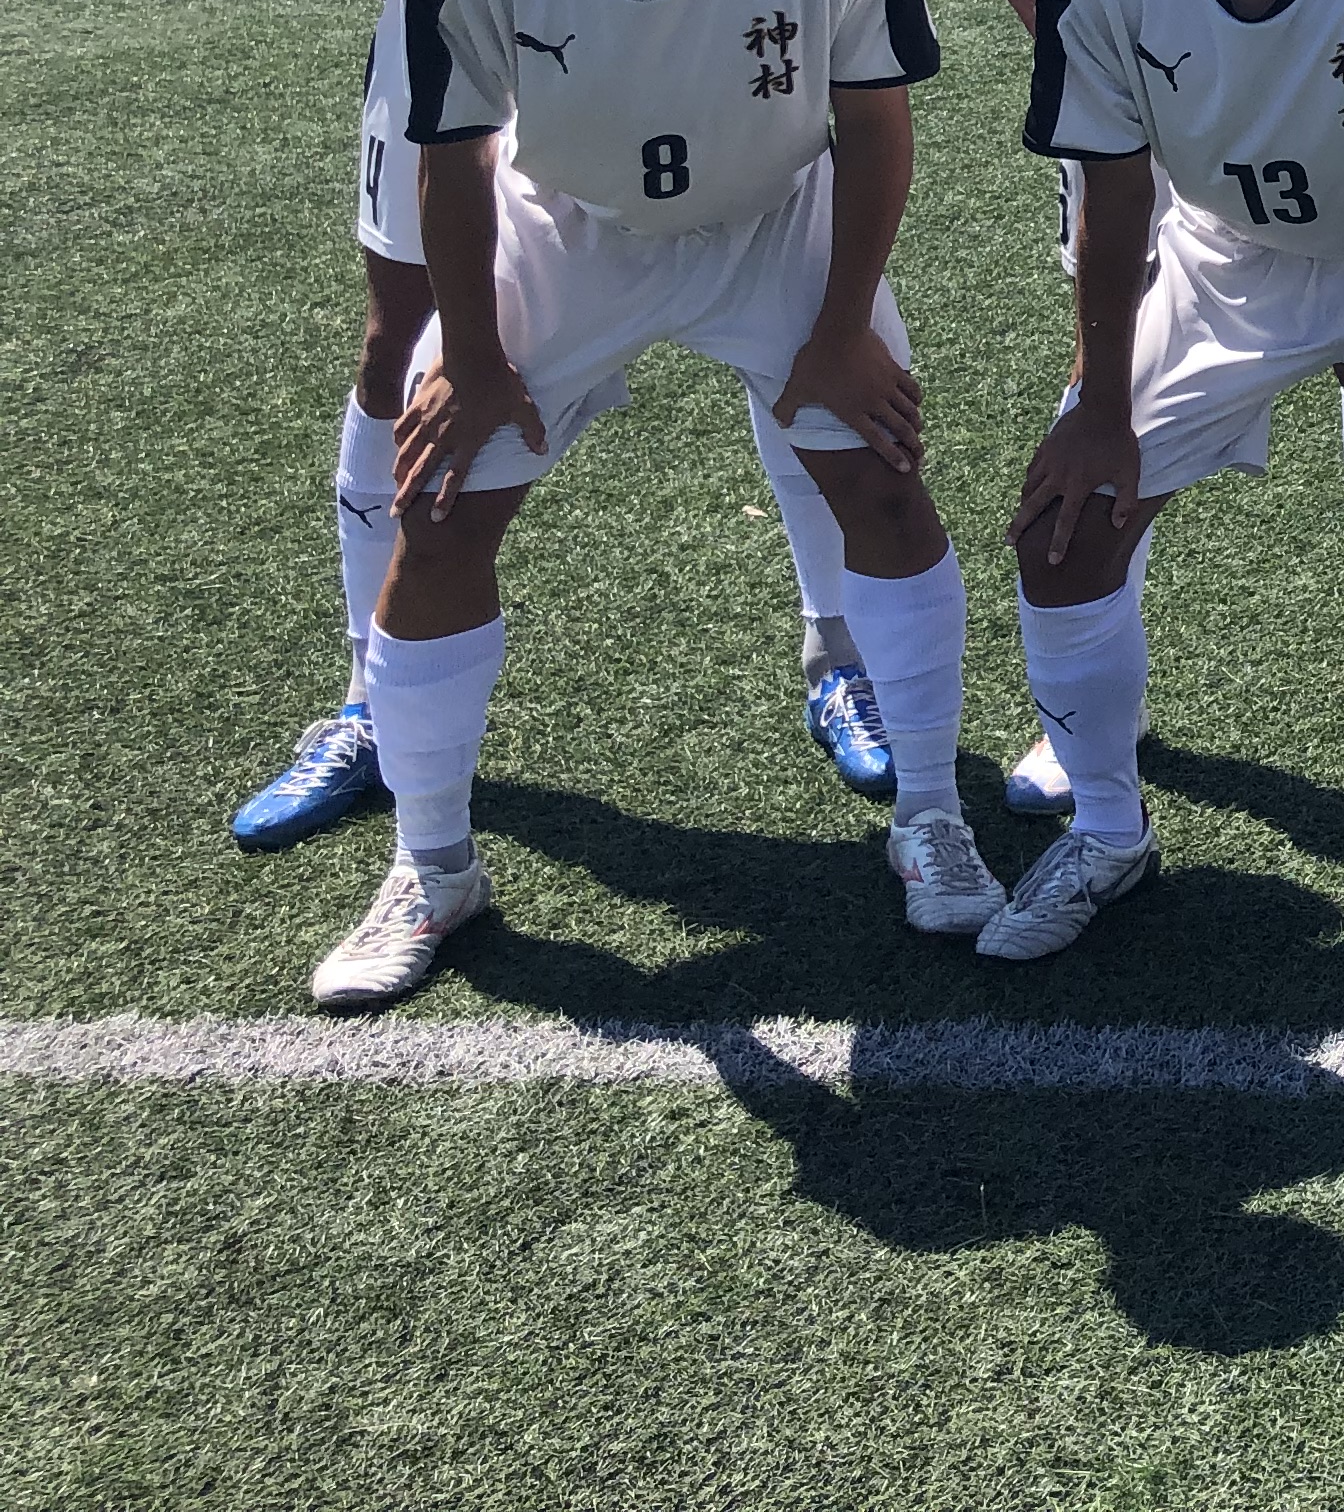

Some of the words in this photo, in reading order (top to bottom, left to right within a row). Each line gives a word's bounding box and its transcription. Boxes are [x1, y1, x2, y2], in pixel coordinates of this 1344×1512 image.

[742, 10, 800, 100] 神村
[641, 134, 690, 200] 8
[1223, 159, 1319, 225] 13
